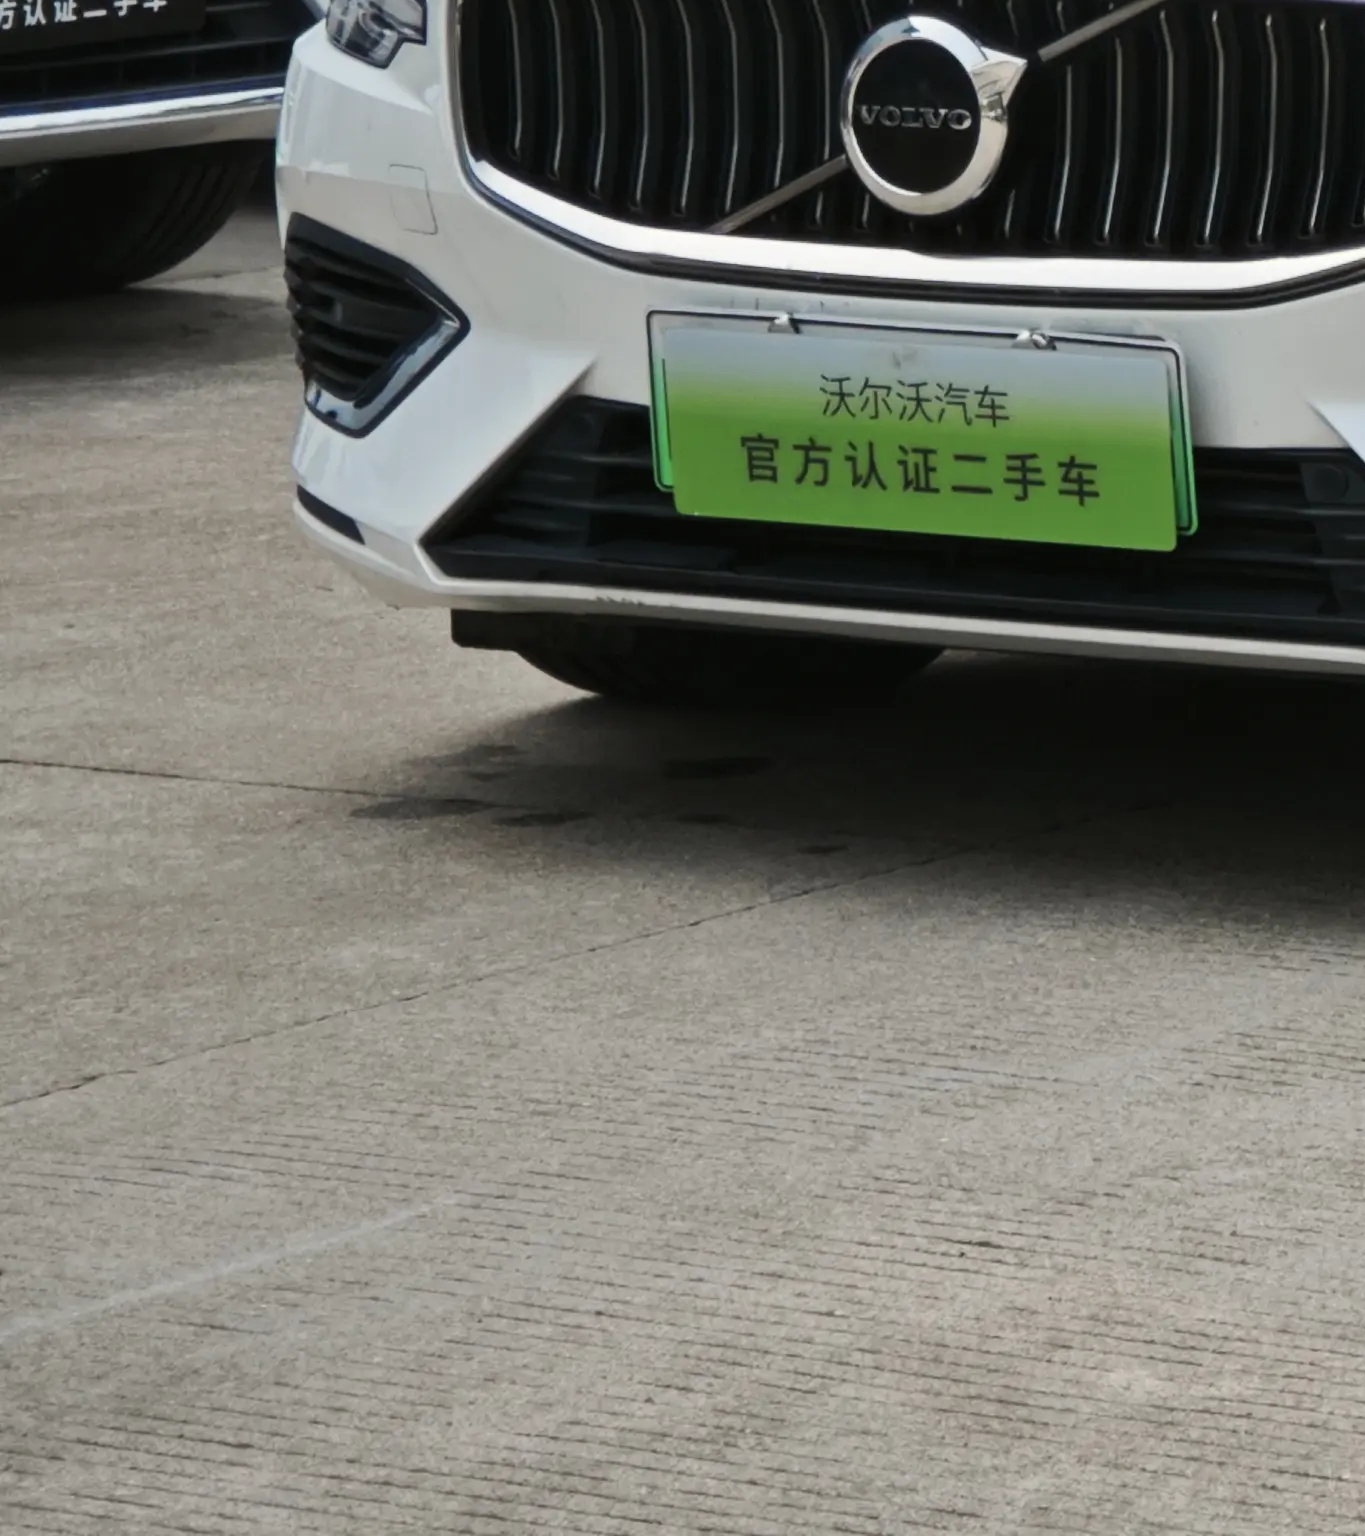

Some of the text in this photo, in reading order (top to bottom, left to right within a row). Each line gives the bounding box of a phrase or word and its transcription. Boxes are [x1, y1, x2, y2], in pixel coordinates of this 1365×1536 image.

[858, 104, 972, 131] VOLVO
[819, 374, 1010, 428] 沃尔沃汽车
[740, 432, 1100, 506] 官方认证二手车
